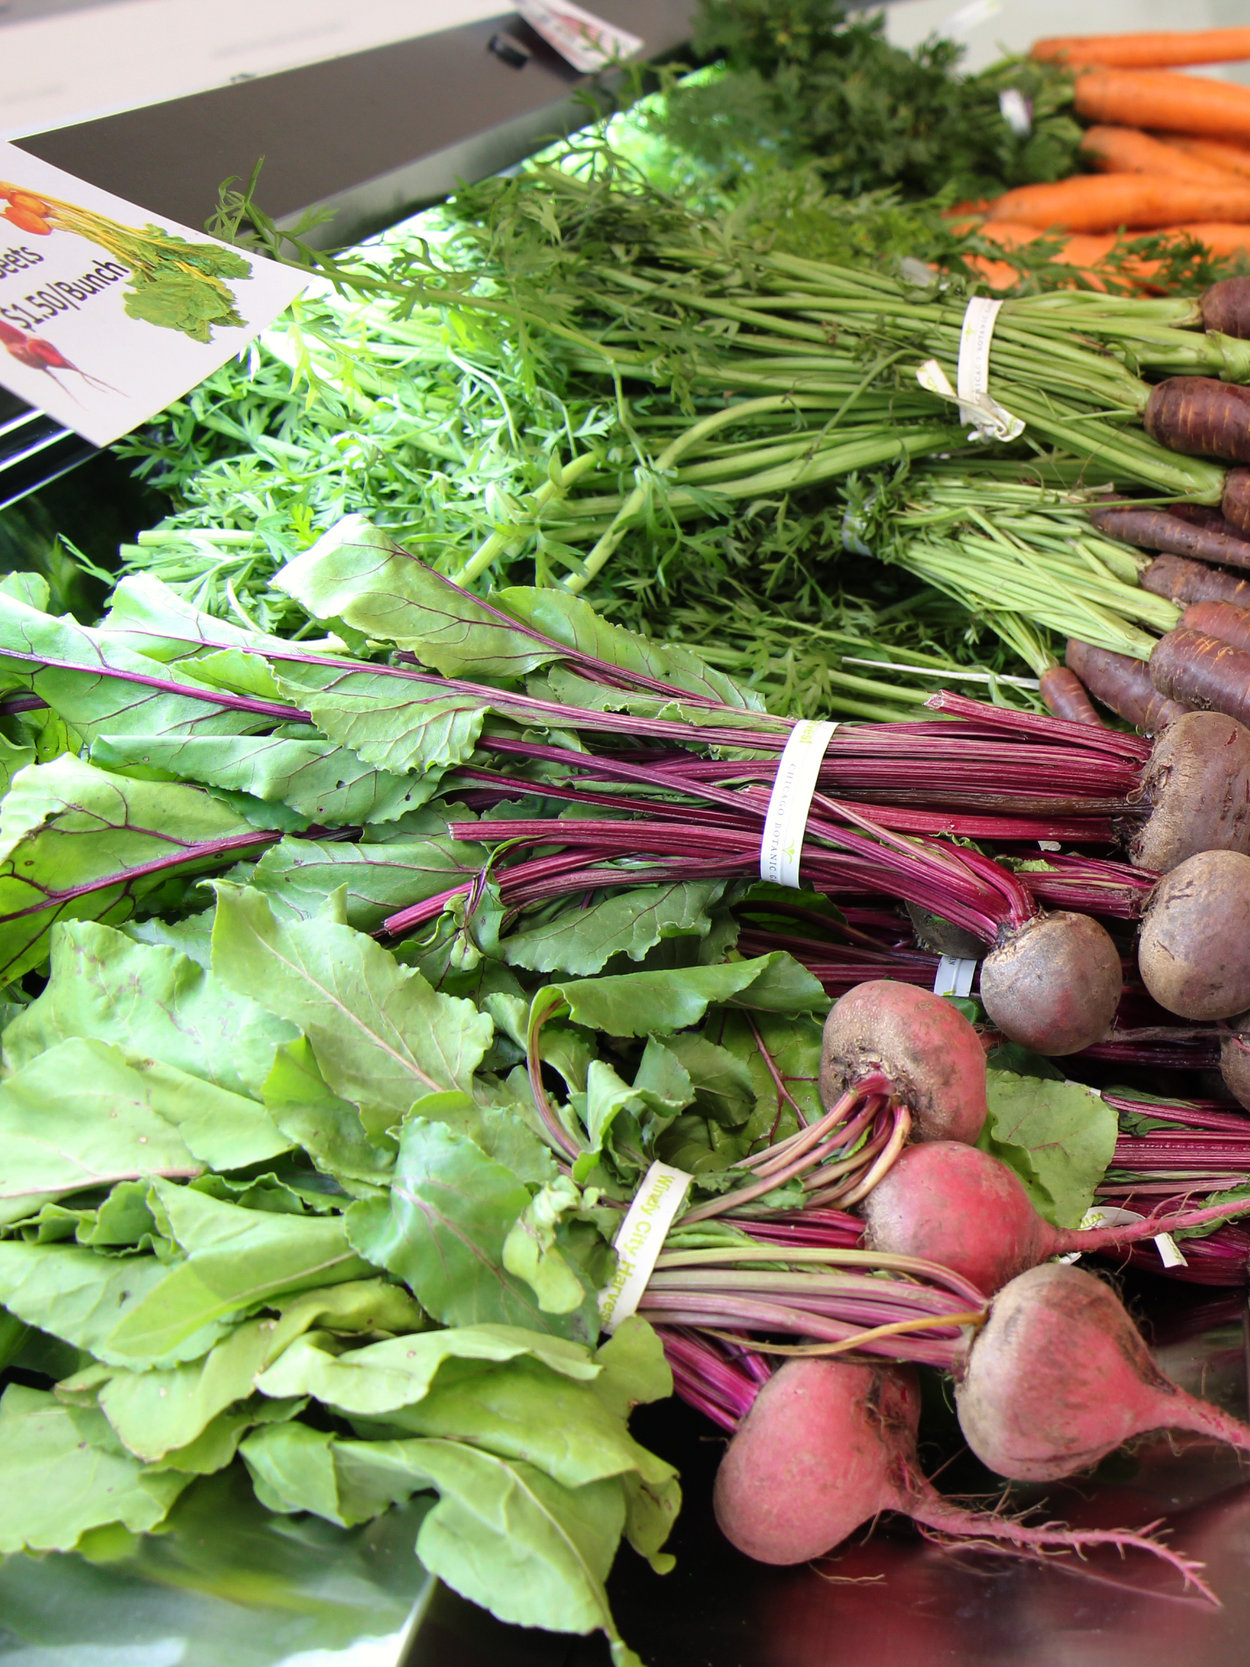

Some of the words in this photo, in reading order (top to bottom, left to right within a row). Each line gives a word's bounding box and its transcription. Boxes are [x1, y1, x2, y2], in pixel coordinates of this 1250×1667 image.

[1, 259, 130, 332] $1.50/Bunch
[779, 763, 796, 816] CHICAGO
[769, 823, 782, 871] BOTANIC
[640, 1174, 675, 1216] Windy
[624, 1221, 651, 1256] City
